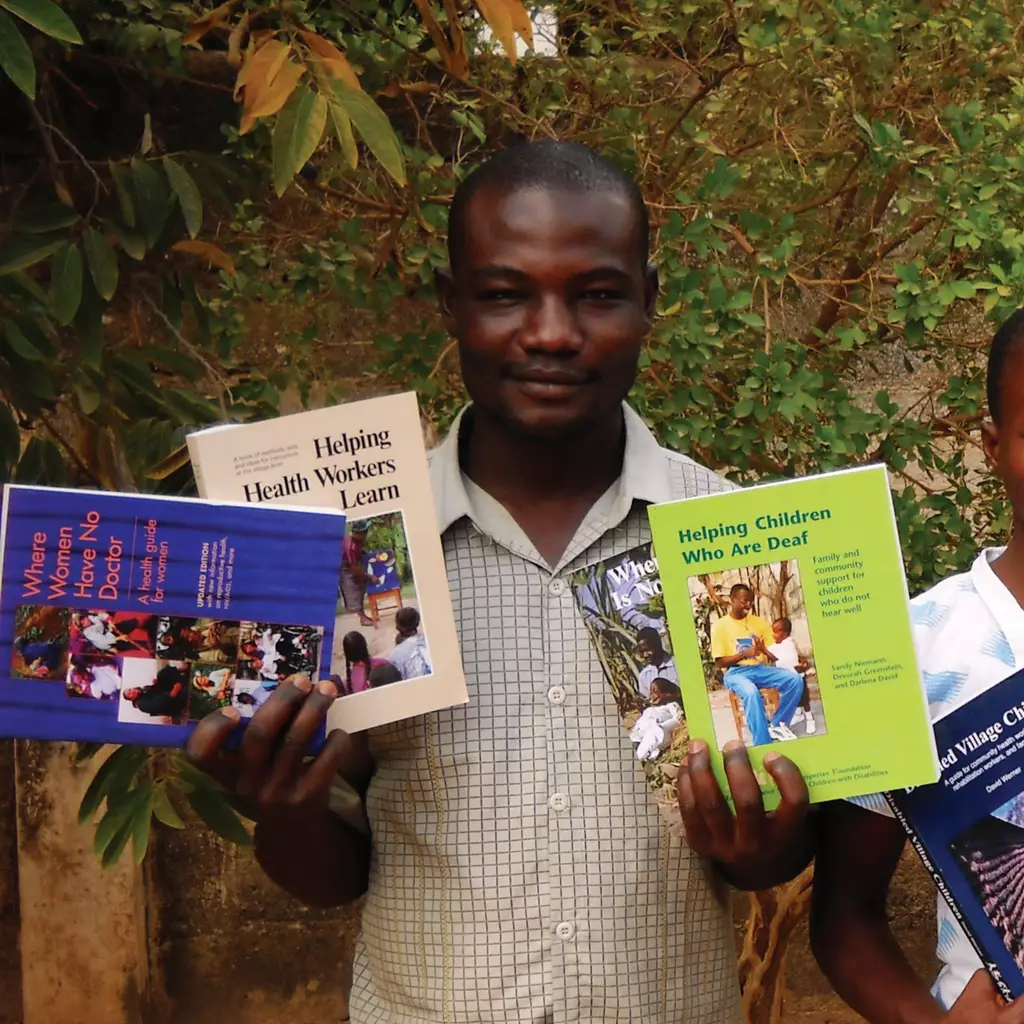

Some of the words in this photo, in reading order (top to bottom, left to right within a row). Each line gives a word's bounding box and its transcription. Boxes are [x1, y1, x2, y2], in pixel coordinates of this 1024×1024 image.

[313, 429, 392, 459] Helping
[242, 473, 310, 503] Health
[313, 459, 396, 487] Workers
[340, 484, 400, 510] Learn
[78, 510, 100, 542] No
[143, 519, 158, 553] guide
[678, 523, 748, 544] Helping
[755, 508, 831, 530] Children
[48, 526, 73, 599] Women
[200, 542, 209, 573] EDITION
[682, 548, 725, 565] Who
[731, 543, 762, 557] Are
[767, 530, 809, 550] Deaf
[812, 553, 841, 564] Family
[843, 549, 860, 559] and
[22, 532, 46, 598] Where
[73, 548, 97, 598] Have
[98, 536, 123, 600] Doctor
[137, 556, 153, 591] health
[150, 587, 164, 603] for
[157, 541, 168, 583] women
[814, 560, 863, 575] community
[816, 574, 850, 586] support
[138, 595, 149, 605] A
[196, 574, 207, 608] UPDATED
[610, 591, 632, 611] Is
[818, 585, 854, 596] children
[820, 598, 840, 607] who
[855, 592, 871, 600] not
[822, 609, 841, 618] hear
[844, 604, 862, 614] well
[832, 662, 852, 671] Sandy
[877, 673, 898, 682] David
[955, 721, 1004, 756] Village
[832, 764, 871, 775] Foundation
[944, 779, 950, 787] A
[948, 771, 963, 785] guide
[962, 765, 971, 774] for
[970, 747, 998, 769] community
[997, 736, 1016, 751] health
[952, 767, 985, 792] rehabilitation
[983, 753, 1007, 770] workers,
[1005, 746, 1017, 756] and
[808, 778, 836, 788] Children
[985, 779, 1002, 793] David
[1000, 766, 1021, 783] Werner
[885, 791, 913, 835] Disabled
[912, 835, 934, 873] Village
[933, 873, 963, 920] Children
